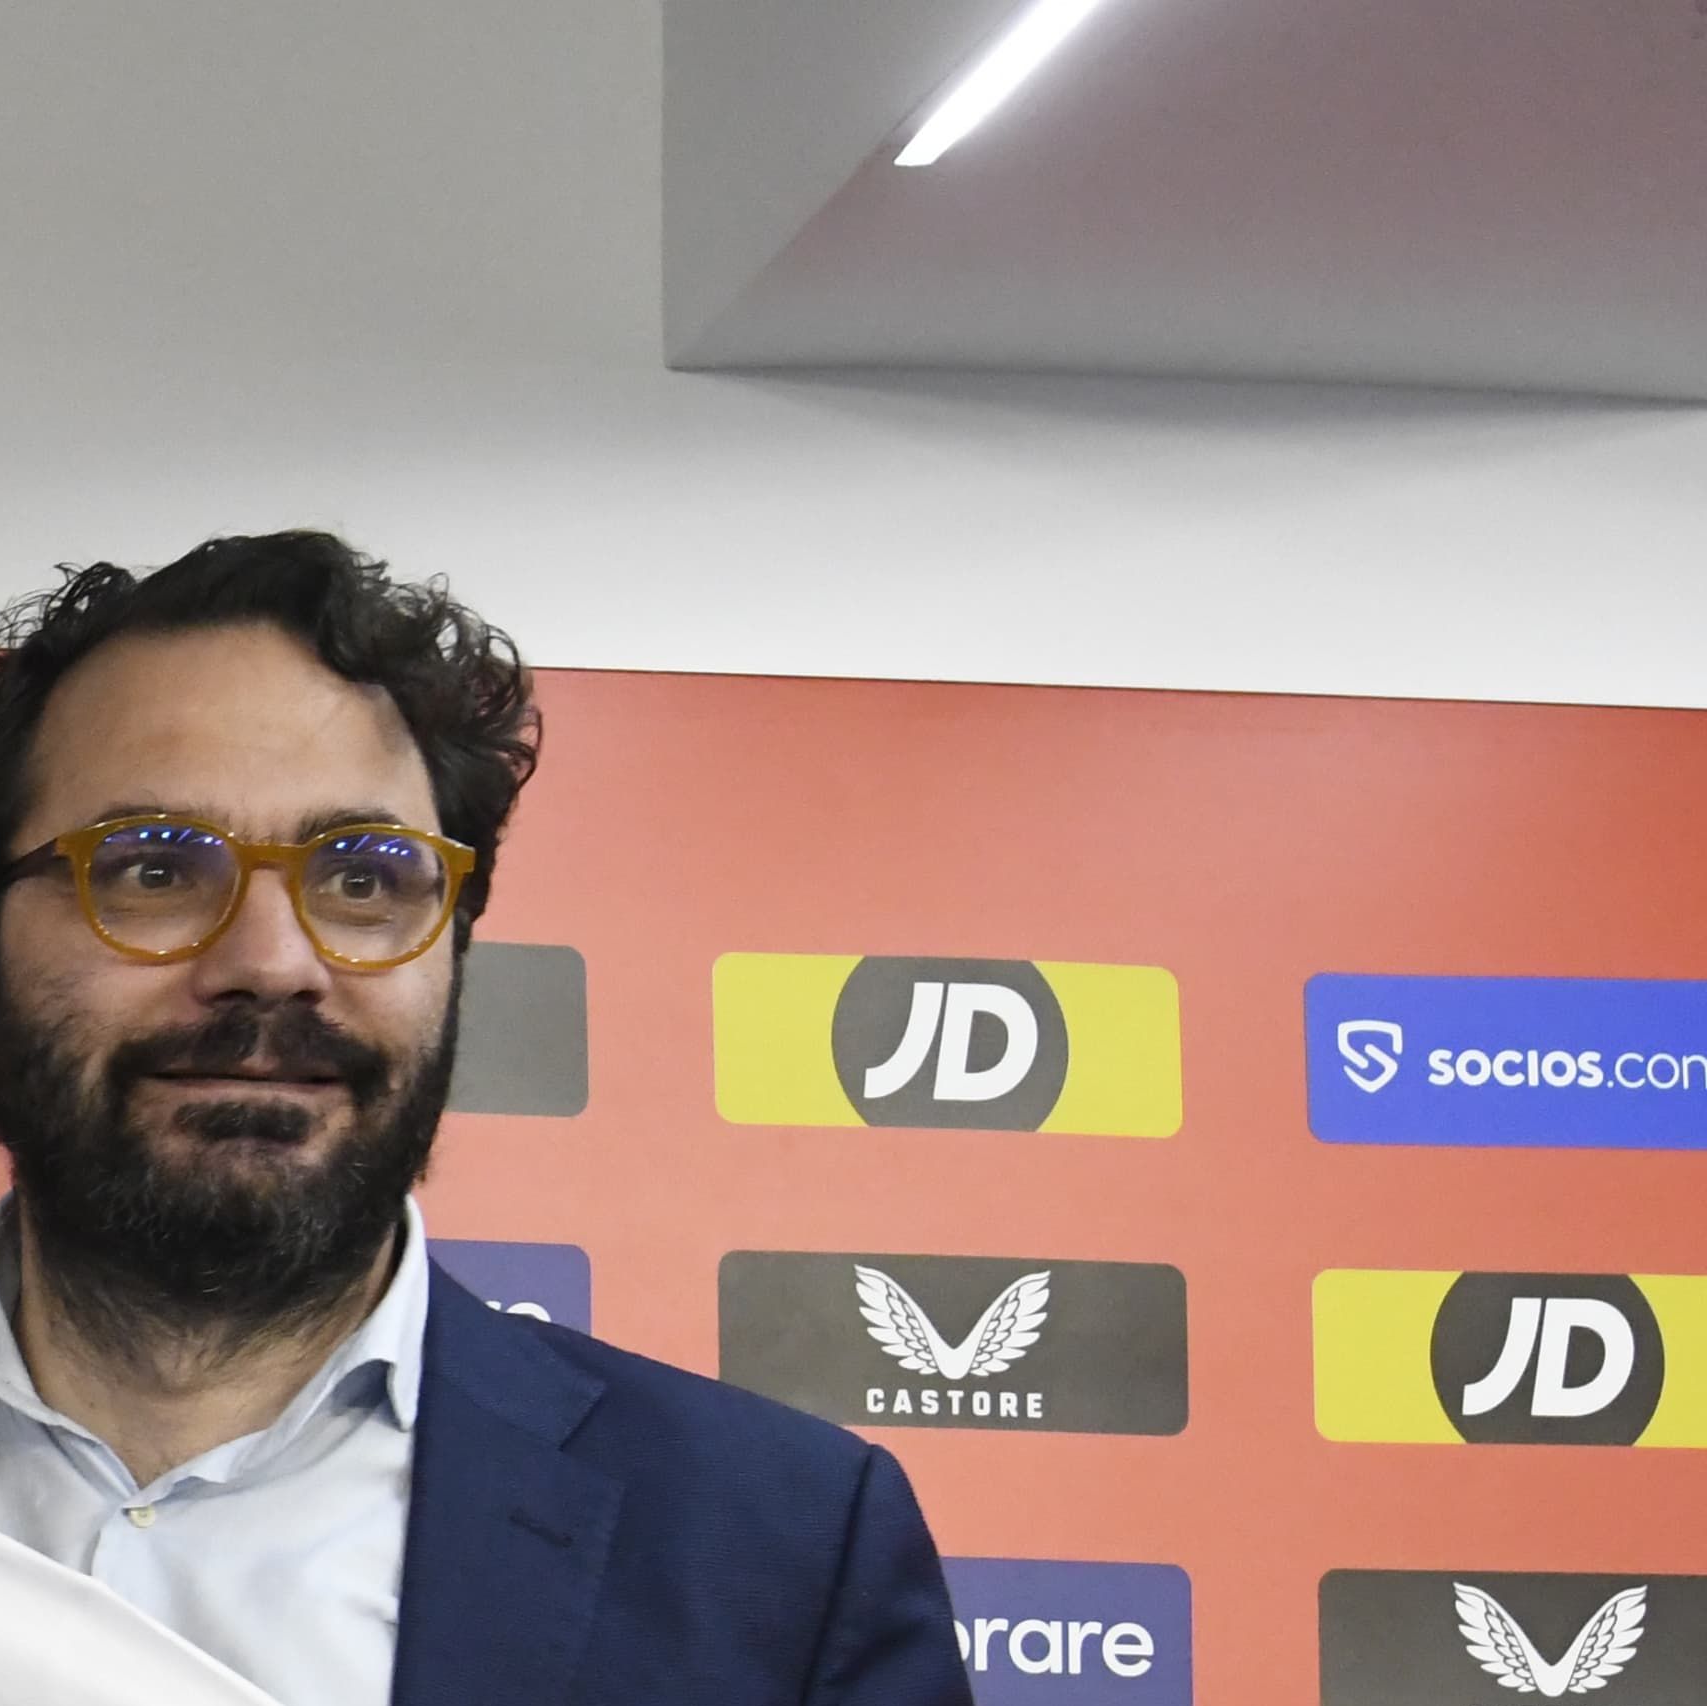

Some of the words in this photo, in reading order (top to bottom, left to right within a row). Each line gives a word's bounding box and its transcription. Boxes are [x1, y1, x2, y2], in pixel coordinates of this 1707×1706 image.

[863, 981, 1038, 1102] JD
[1463, 1297, 1635, 1417] JD
[866, 1388, 1043, 1419] CASTORE
[954, 1618, 1155, 1677] rare
